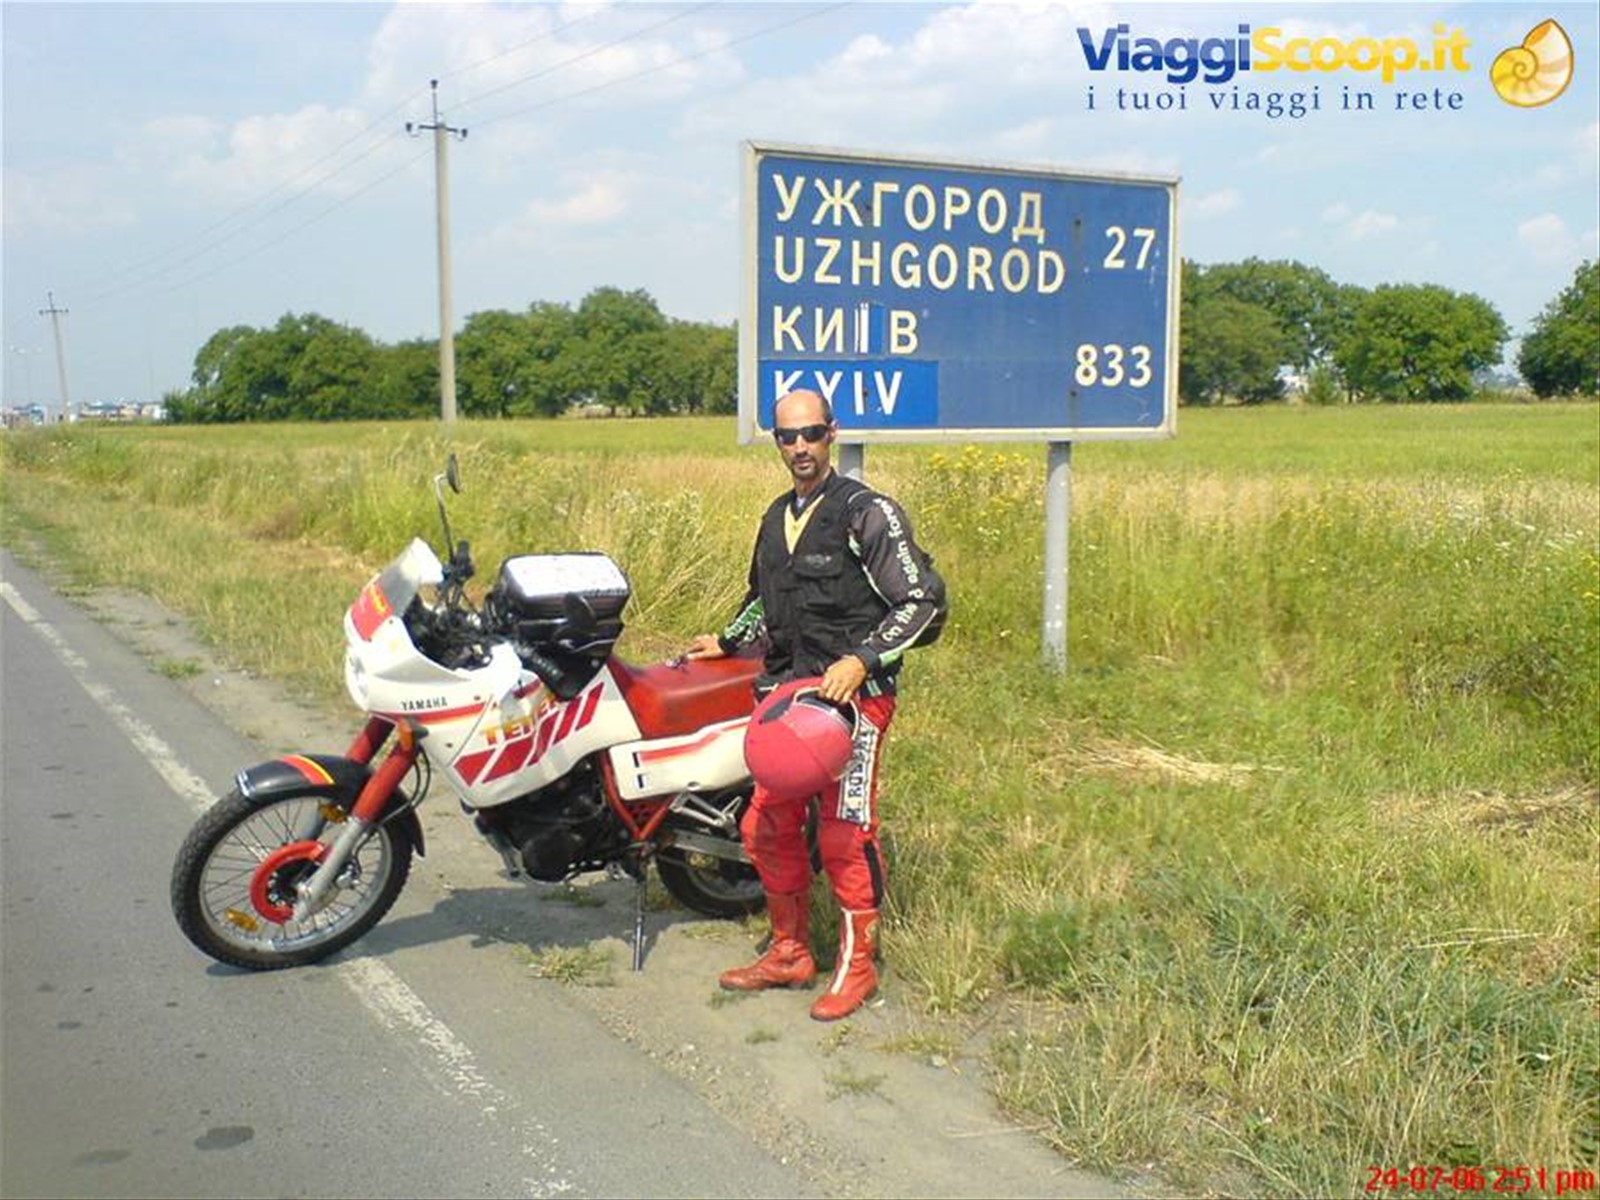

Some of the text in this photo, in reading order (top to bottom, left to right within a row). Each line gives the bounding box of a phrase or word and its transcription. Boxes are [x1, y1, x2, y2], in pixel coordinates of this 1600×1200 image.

[772, 173, 1046, 244] УЖГОРОД
[774, 235, 1066, 294] UZHGOROD
[1104, 226, 1156, 270] 27
[1074, 344, 1152, 387] 833
[401, 696, 448, 711] YAMAHA
